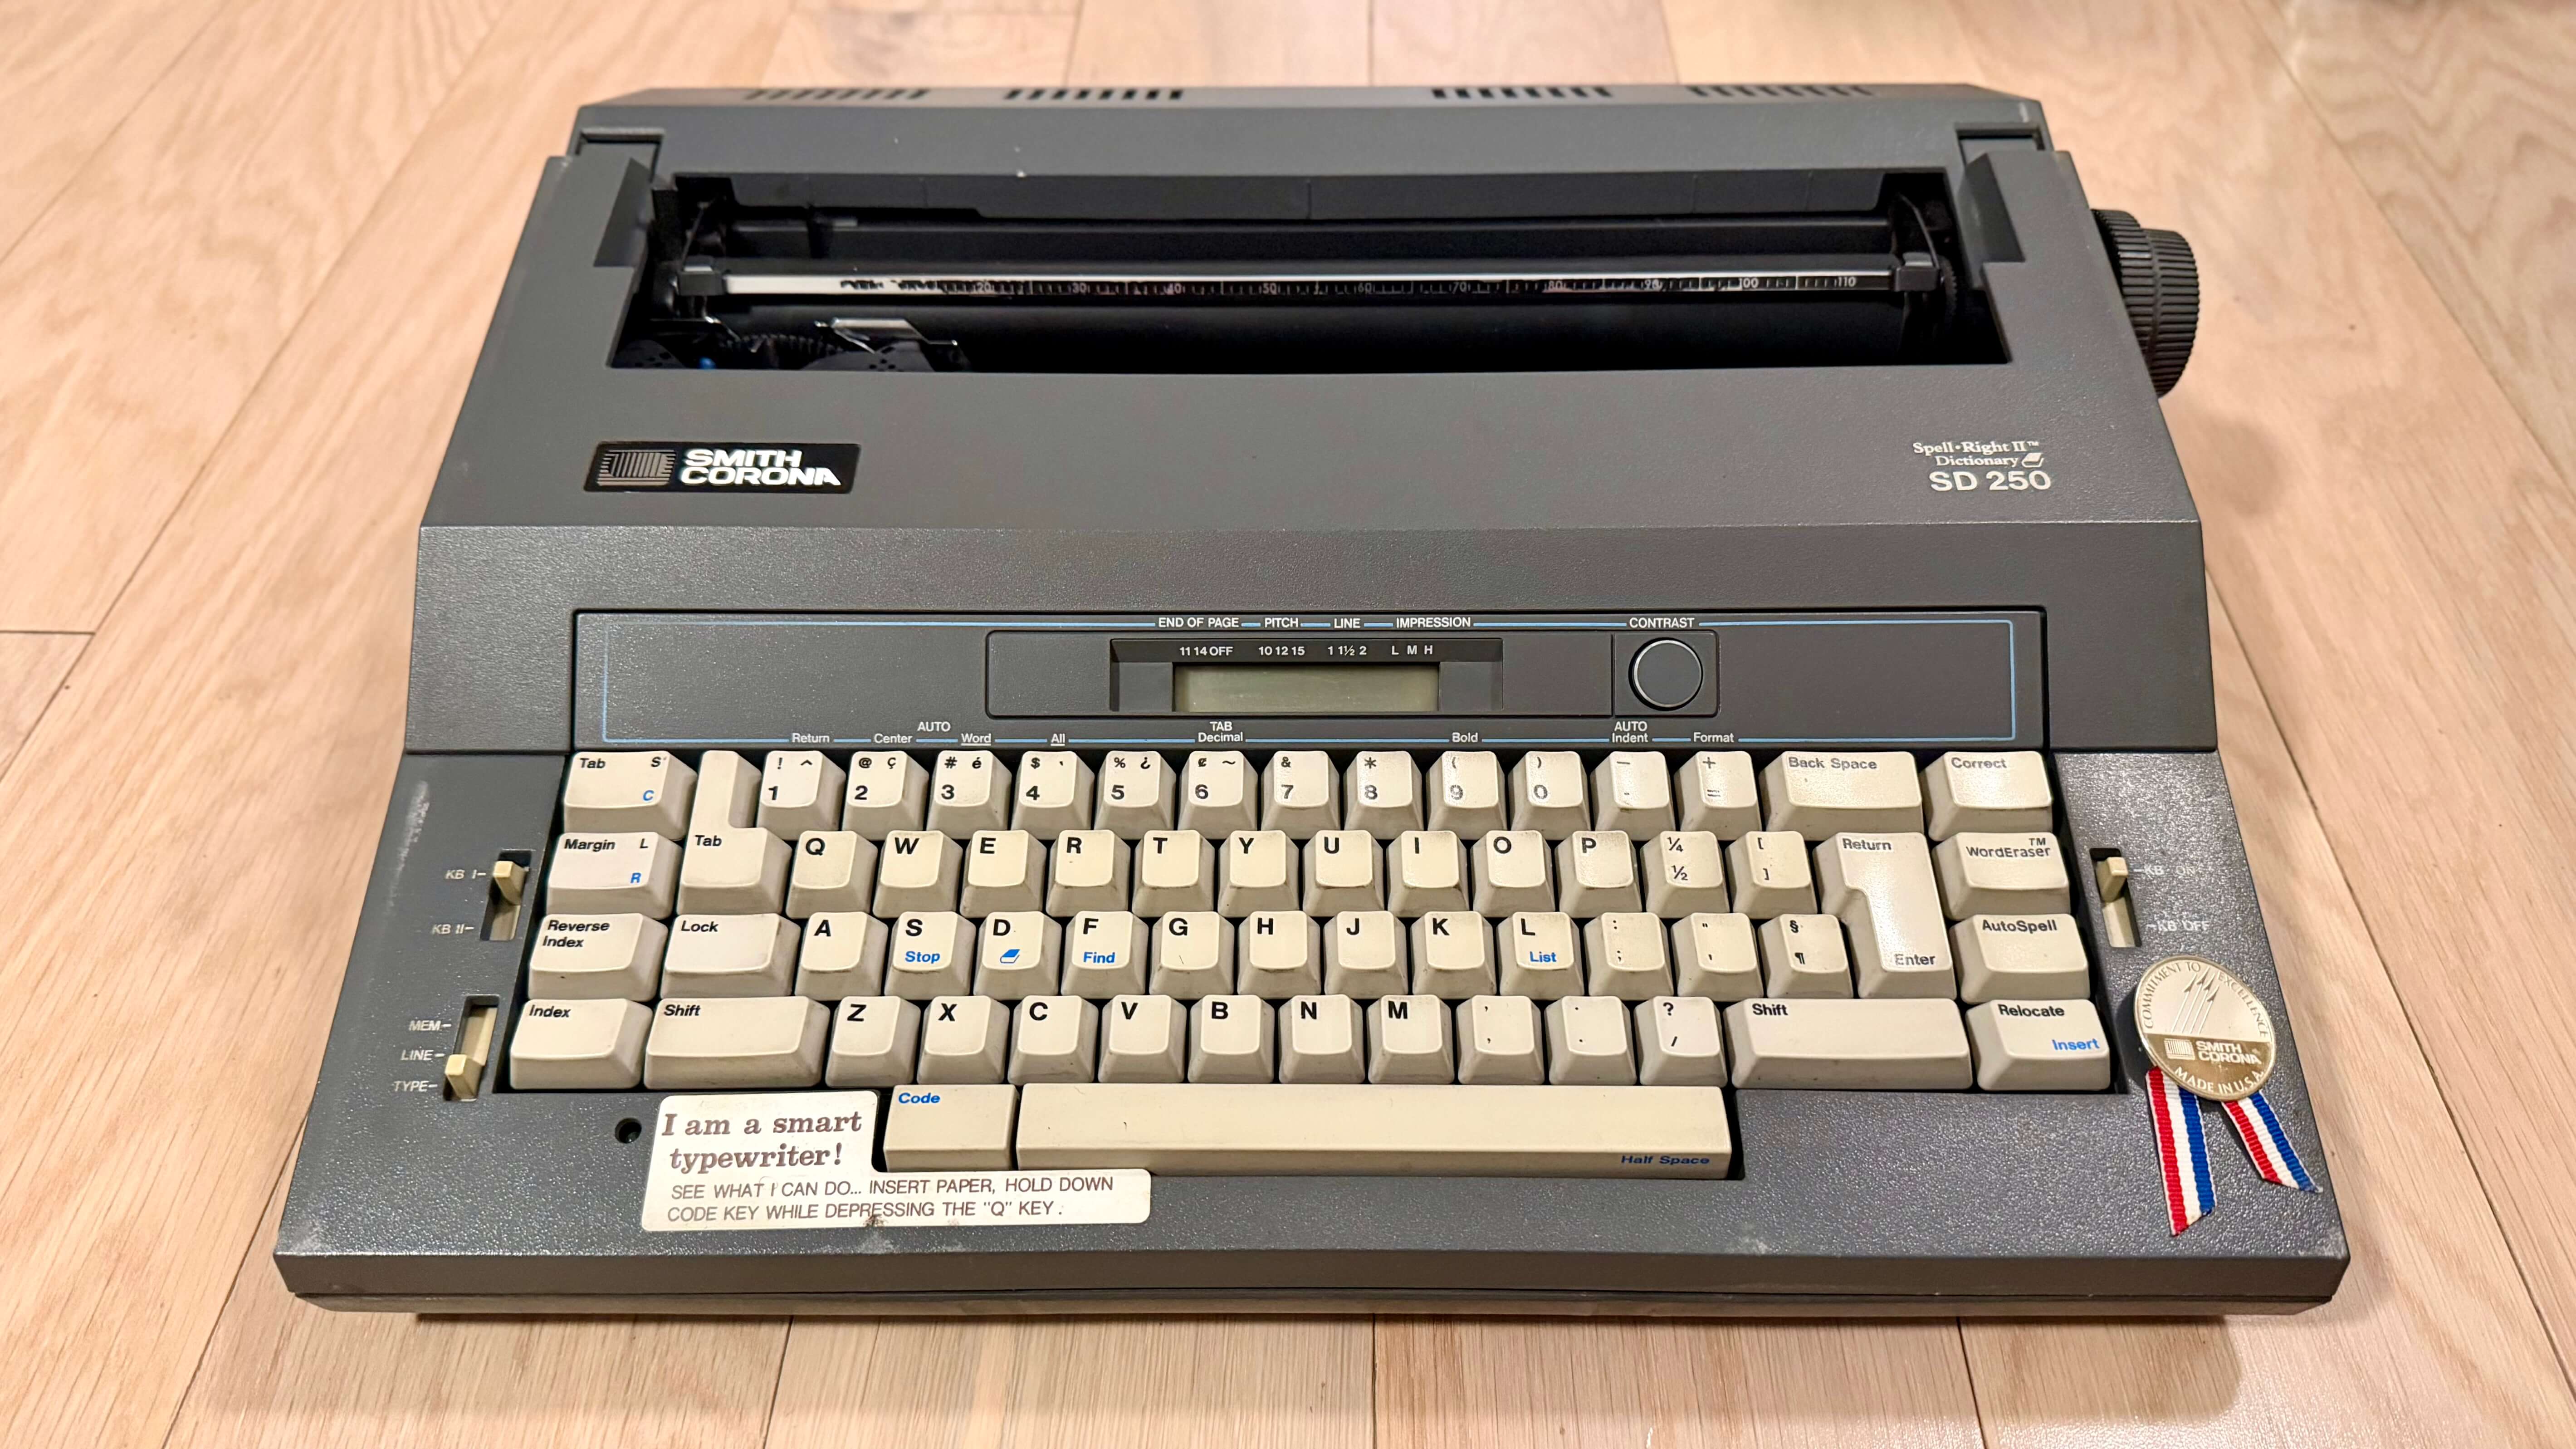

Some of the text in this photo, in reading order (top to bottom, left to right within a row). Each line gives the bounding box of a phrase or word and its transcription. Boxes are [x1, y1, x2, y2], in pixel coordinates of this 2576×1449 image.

[1072, 283, 1086, 294] 30
[1262, 283, 1277, 294] 50
[1453, 281, 1467, 293] 70
[1548, 280, 1564, 292] 80
[1740, 277, 1759, 289] 100
[1838, 277, 1856, 287] 110
[684, 449, 802, 467] SMITH
[1935, 455, 2018, 467] Dictionary
[680, 467, 842, 486] CORONA
[1929, 470, 2052, 491] SD 250
[1158, 617, 1239, 627] END OF PAGE
[1265, 617, 1299, 628] PITCH
[1334, 618, 1361, 628] LINE
[1396, 617, 1471, 628] IMPRESSION
[1629, 617, 1695, 628] CONTRAST
[1179, 646, 1233, 656] 11 14 OFF
[1258, 646, 1305, 656] 10 12 15
[1328, 646, 1334, 655] 1
[1359, 646, 1367, 655] 2
[1392, 645, 1433, 655] L M H
[917, 722, 951, 732] AUTO
[1210, 721, 1233, 732] TAB
[1614, 721, 1648, 731] AUTO
[792, 733, 830, 744] Return
[874, 733, 913, 744] Center
[961, 733, 992, 744] Word
[1051, 733, 1066, 744] All
[1198, 732, 1243, 743] Decimal
[1452, 732, 1478, 743] Bold
[1612, 733, 1648, 743] Indent
[1693, 732, 1734, 743] Format
[580, 758, 606, 769] Tab
[1788, 757, 1877, 770] Back Space
[1951, 757, 2007, 769] Correct
[643, 790, 654, 801] C
[768, 786, 778, 801] 1
[855, 786, 869, 800] 2
[941, 785, 955, 800] 3
[1026, 786, 1040, 800] 4
[1111, 785, 1124, 799] 5
[1195, 784, 1209, 799] 6
[1281, 785, 1294, 799] 7
[1364, 785, 1378, 800] 8
[1450, 784, 1463, 800] 9
[564, 839, 616, 852] Margin
[640, 839, 648, 849] L
[695, 835, 722, 847] Tab
[806, 838, 826, 855] Q
[895, 837, 919, 854] W
[980, 837, 996, 854] E
[1066, 837, 1082, 854] R
[1153, 837, 1168, 854] T
[1239, 837, 1254, 854] Y
[1325, 837, 1339, 854] U
[1414, 837, 1420, 854] I
[1493, 837, 1512, 854] O
[1582, 837, 1597, 853] P
[1842, 838, 1892, 851] Return
[1965, 846, 2052, 858] WordEraser
[445, 870, 477, 880] KB I
[631, 873, 641, 884] R
[431, 924, 451, 935] KB
[547, 920, 610, 932] Reverse
[681, 920, 719, 932] Lock
[814, 919, 831, 937] A
[905, 918, 923, 936] S
[993, 919, 1011, 936] D
[1083, 918, 1099, 935] F
[1168, 918, 1188, 936] G
[1257, 918, 1274, 935] H
[1346, 918, 1360, 935] J
[1432, 918, 1449, 935] K
[1520, 918, 1535, 935] L
[1982, 919, 2058, 933] AutoSpell
[543, 935, 584, 948] Index
[905, 950, 941, 964] Stop
[1083, 952, 1115, 964] Find
[1530, 951, 1557, 962] List
[1895, 954, 1936, 966] Enter
[2142, 961, 2268, 1038] COMMITMENT TO EXCELLENCE
[529, 1004, 570, 1018] Index
[664, 1004, 701, 1017] Shift
[847, 1004, 867, 1022] Z
[938, 1003, 957, 1021] X
[1029, 1002, 1048, 1021] C
[1121, 1002, 1138, 1019] V
[1212, 1002, 1228, 1019] B
[1300, 1001, 1317, 1019] N
[1388, 1001, 1408, 1019] M
[1752, 1003, 1789, 1016] Shift
[1998, 1004, 2065, 1017] Relocate
[2052, 1038, 2101, 1051] Insert
[2195, 1041, 2242, 1052] SMITH
[401, 1050, 434, 1061] LINE
[2198, 1052, 2262, 1065] CORONA
[394, 1080, 430, 1092] TYPE
[2174, 1066, 2264, 1094] MADE IN U.S.A.
[898, 1092, 940, 1104] Code
[661, 1111, 862, 1136] I am a smart
[670, 1142, 842, 1174] typewriter!
[1621, 1155, 1710, 1165] Half Space
[671, 1185, 705, 1199] SEE
[714, 1183, 764, 1198] WHAT
[771, 1184, 776, 1197] I
[781, 1182, 818, 1197] CAN
[869, 1180, 929, 1194] INSERT
[936, 1179, 996, 1195] PAPER,
[1005, 1178, 1052, 1192] HOLD
[1059, 1177, 1113, 1192] DOWN
[668, 1206, 718, 1222] CODE
[723, 1205, 760, 1220] KEY
[767, 1204, 818, 1219] WHILE
[824, 1202, 934, 1219] DEPRESSING
[942, 1202, 976, 1217] THE
